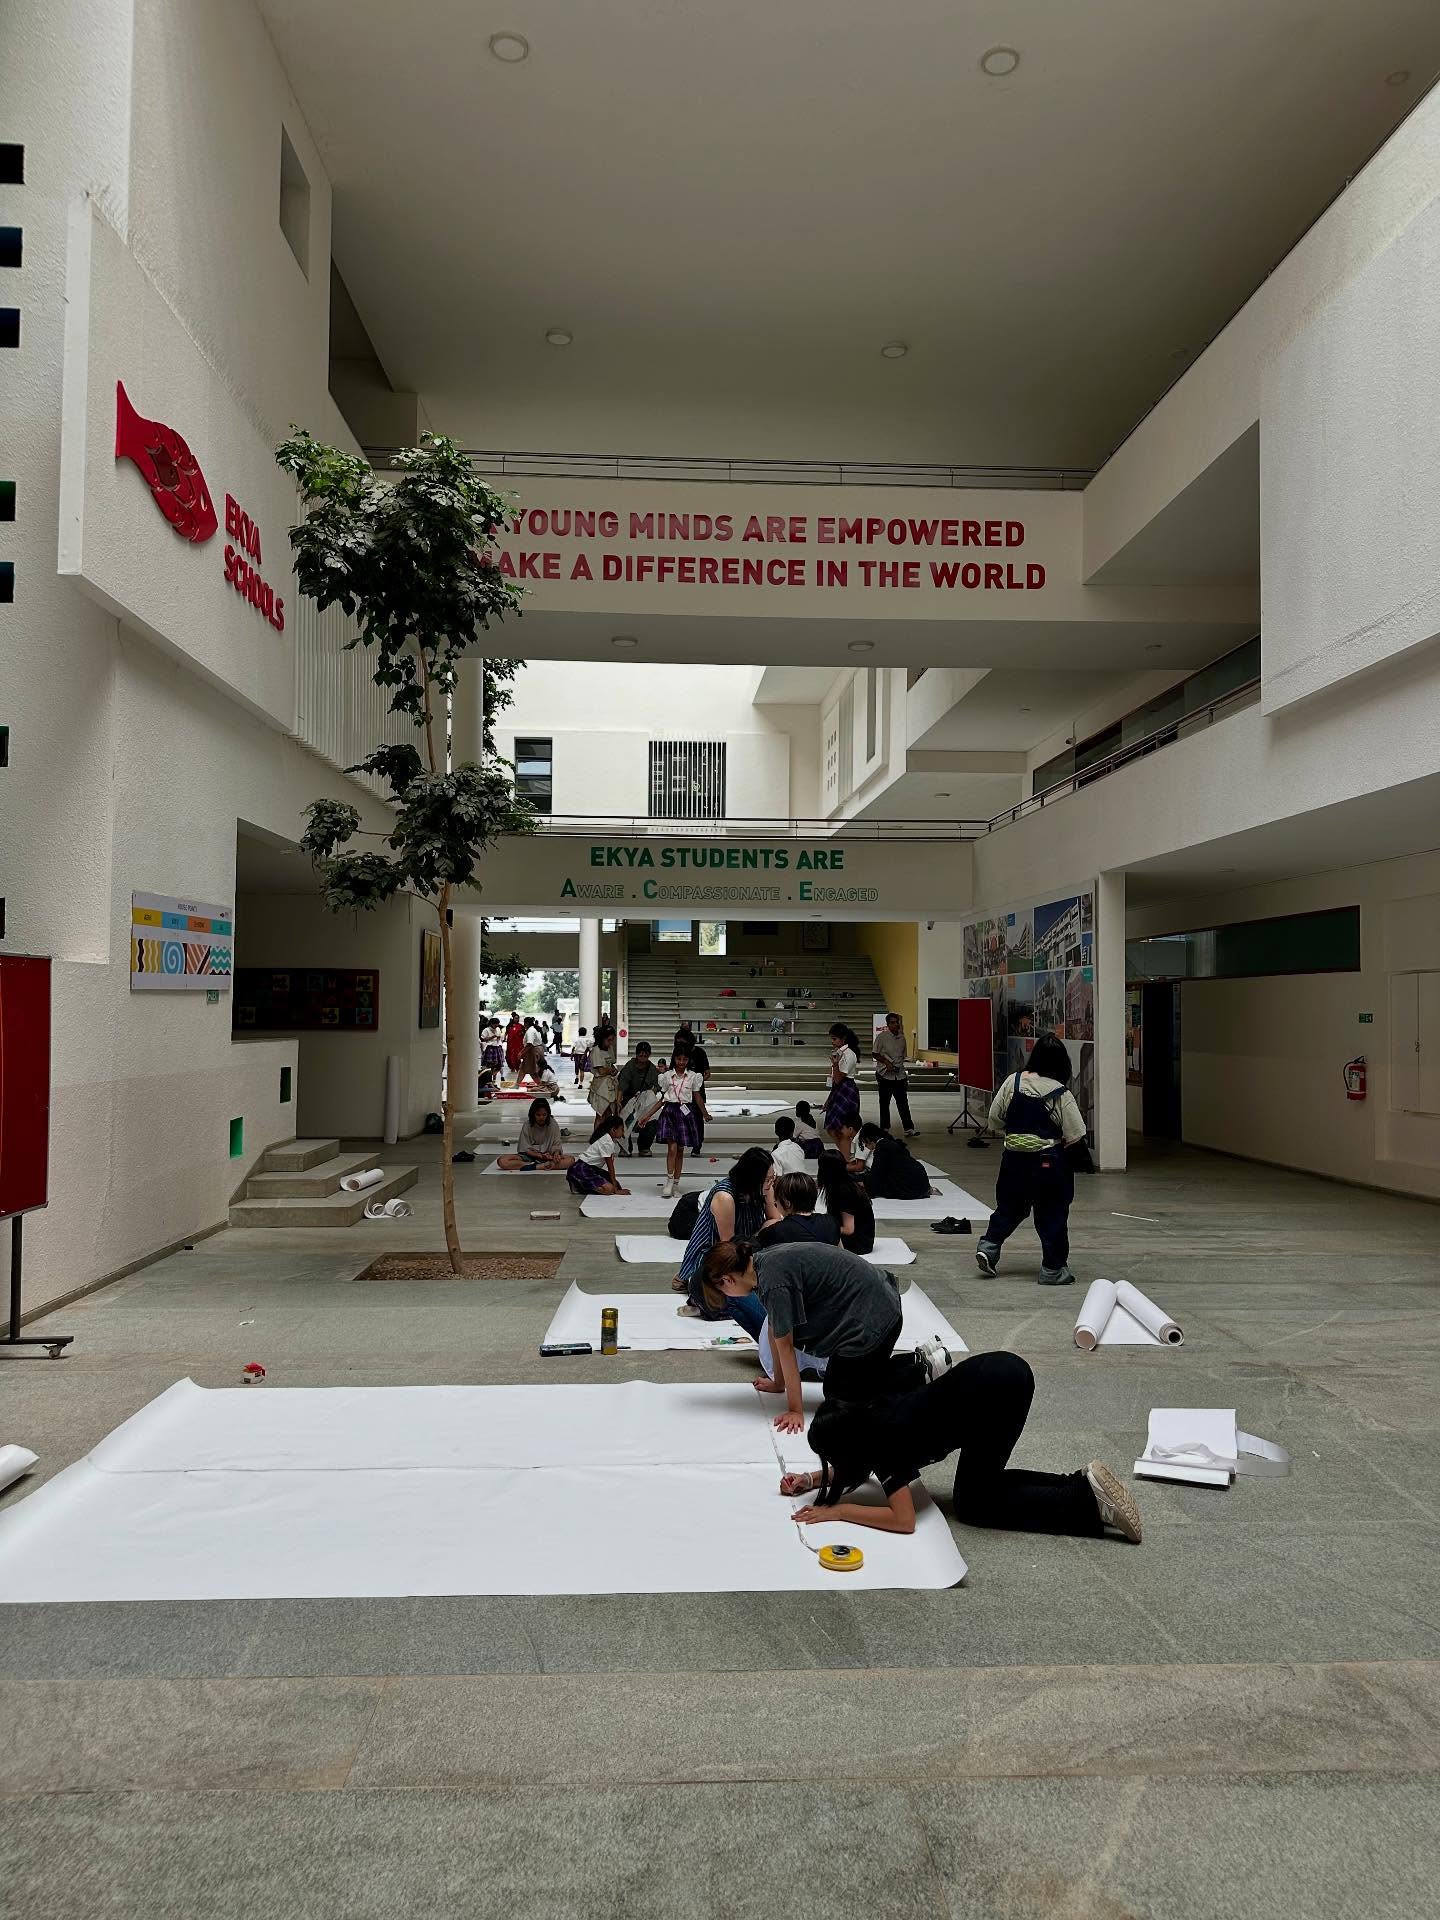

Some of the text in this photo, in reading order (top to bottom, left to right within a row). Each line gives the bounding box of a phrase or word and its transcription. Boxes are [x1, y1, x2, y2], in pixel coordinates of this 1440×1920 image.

[225, 493, 262, 565] EKYA
[511, 508, 619, 538] YOUNG
[629, 512, 734, 542] MINDS
[742, 515, 807, 543] ARE
[817, 517, 1025, 547] EMPOWERED
[223, 544, 285, 632] SCHOOLS
[570, 553, 594, 581] A
[602, 554, 806, 586] DIFFERENCE
[816, 559, 848, 587] IN
[858, 560, 921, 588] THE
[929, 562, 1046, 590] WORLD
[590, 846, 844, 870] EKYA STUDENTS ARE
